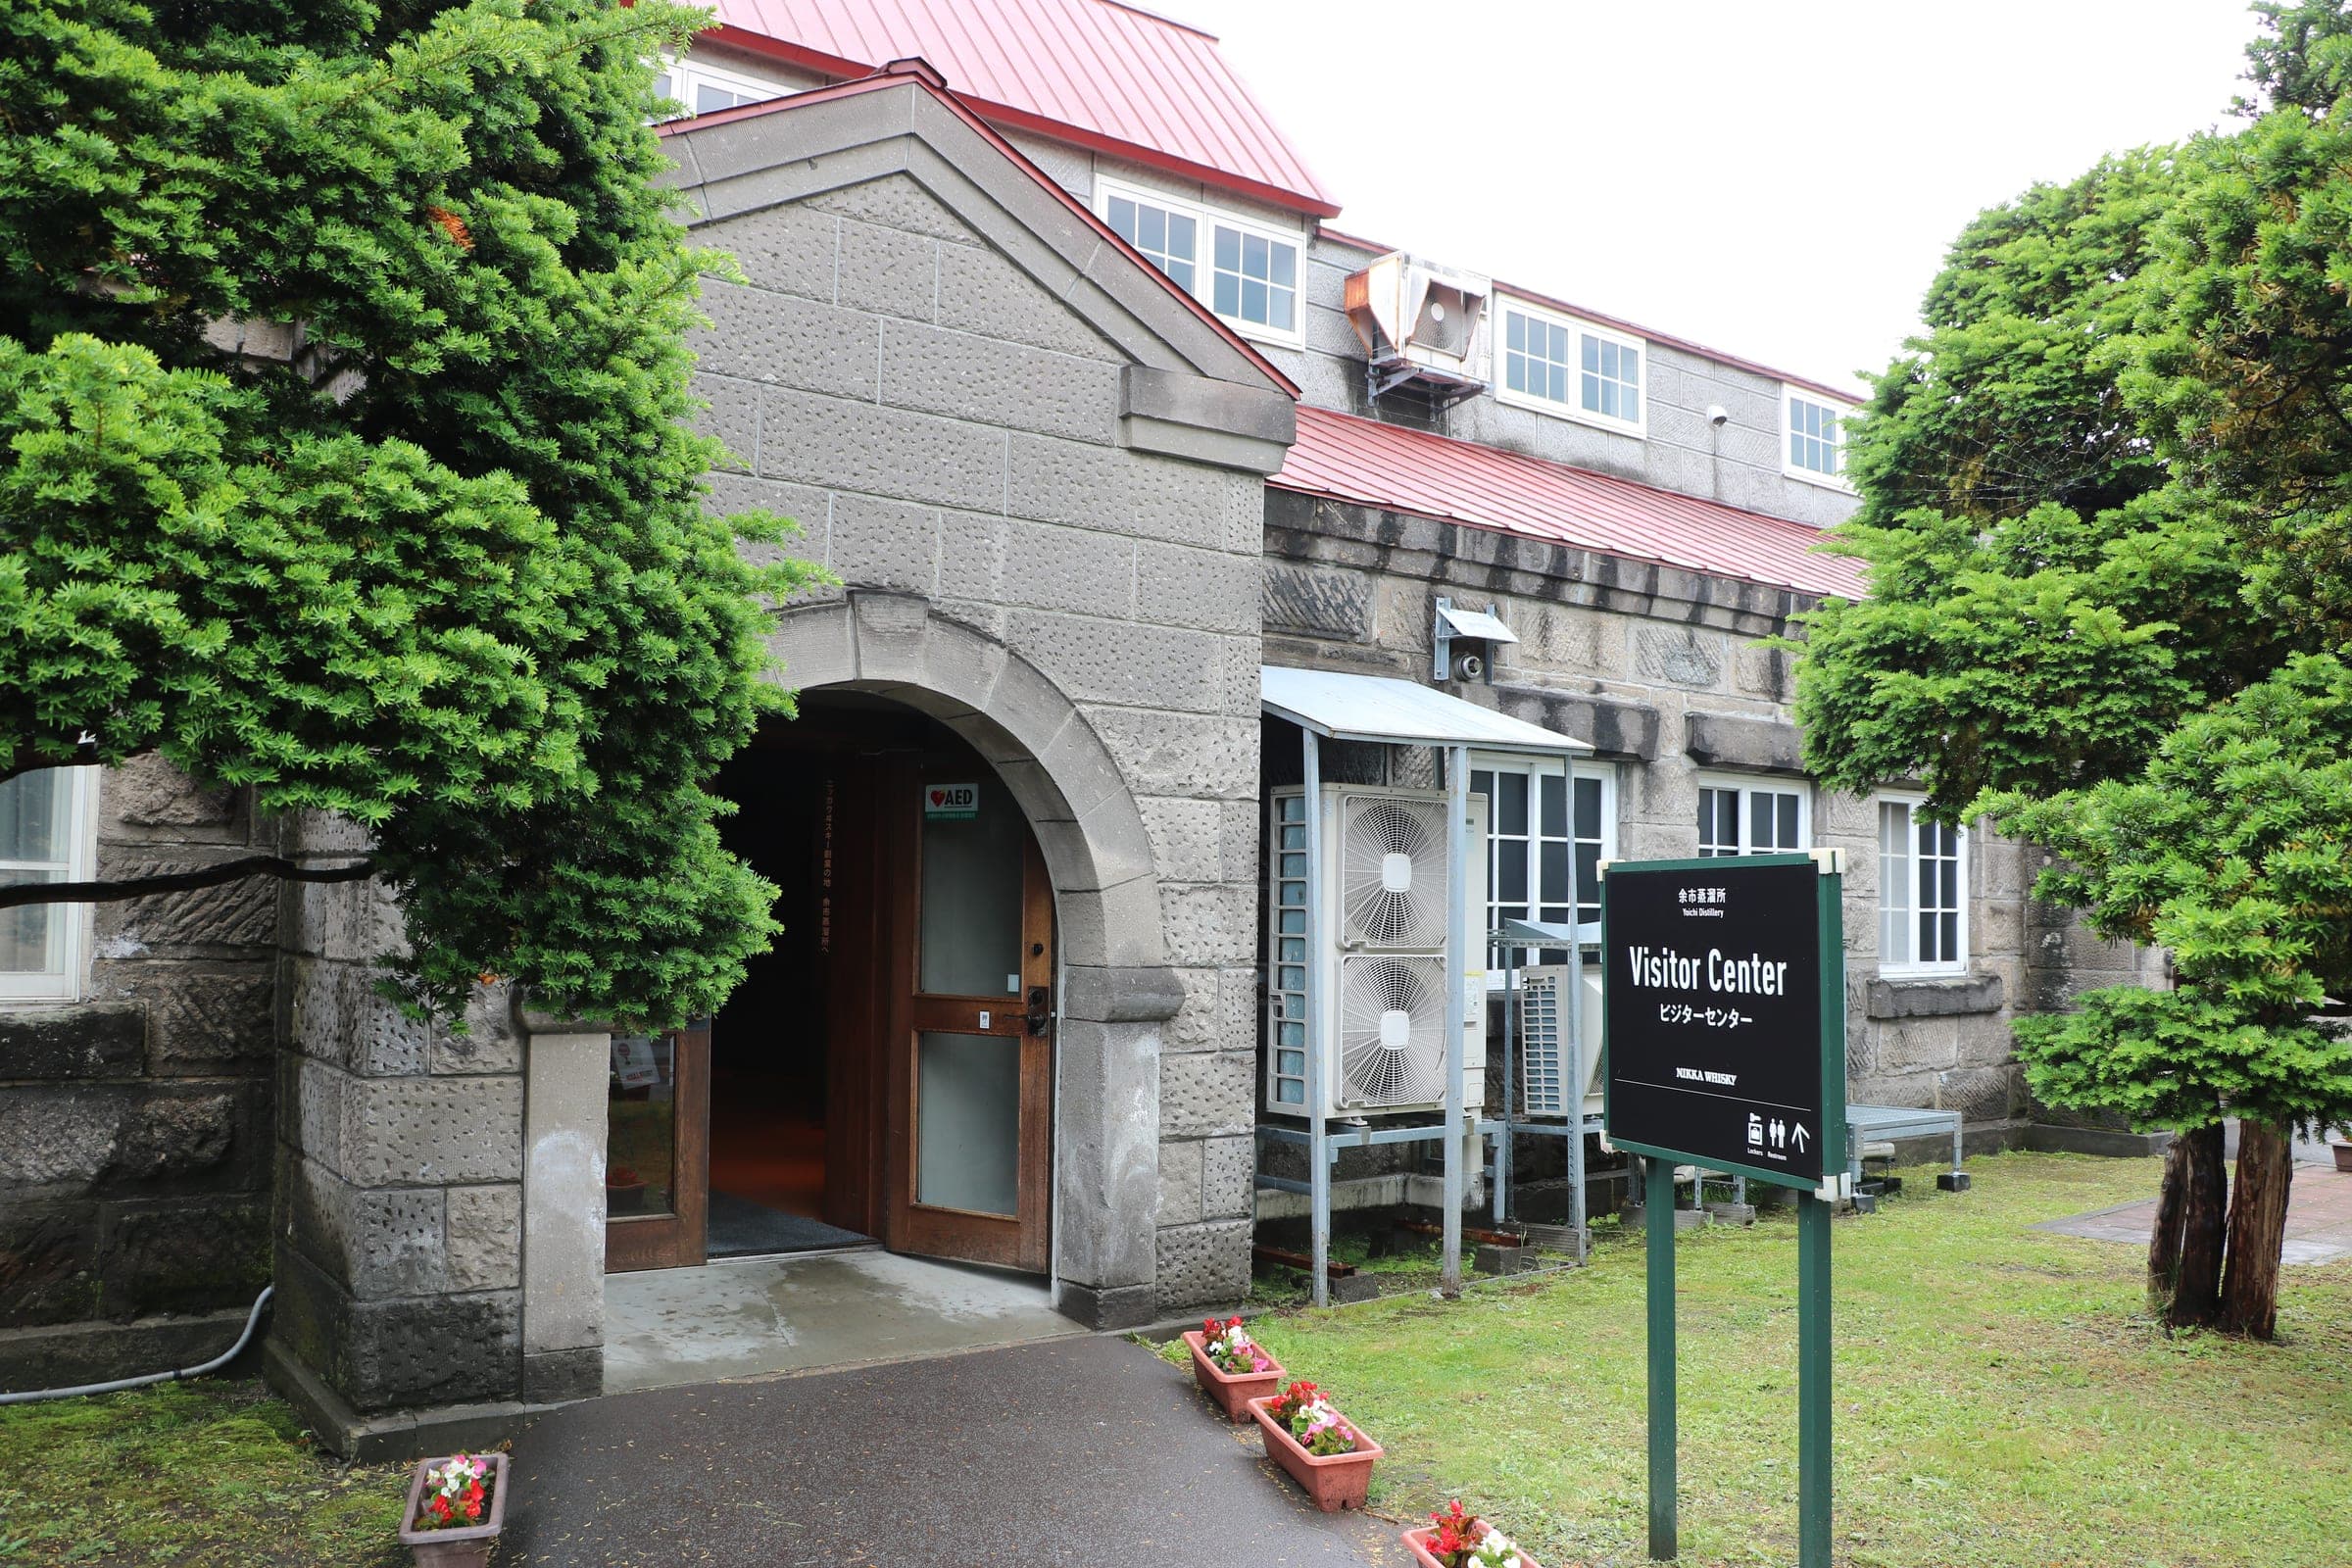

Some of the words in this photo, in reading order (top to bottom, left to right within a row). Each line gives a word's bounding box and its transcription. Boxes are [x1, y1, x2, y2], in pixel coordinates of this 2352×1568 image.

[945, 790, 972, 805] AED
[1678, 888, 1726, 904] 余市蒸溜所
[1699, 907, 1724, 918] Distillery
[1629, 946, 1701, 990] Visitor
[1708, 948, 1788, 996] Center
[1660, 1003, 1752, 1029] ビジターセンター
[1676, 1067, 1704, 1081] NIKKA
[1704, 1071, 1737, 1086] WHISKY
